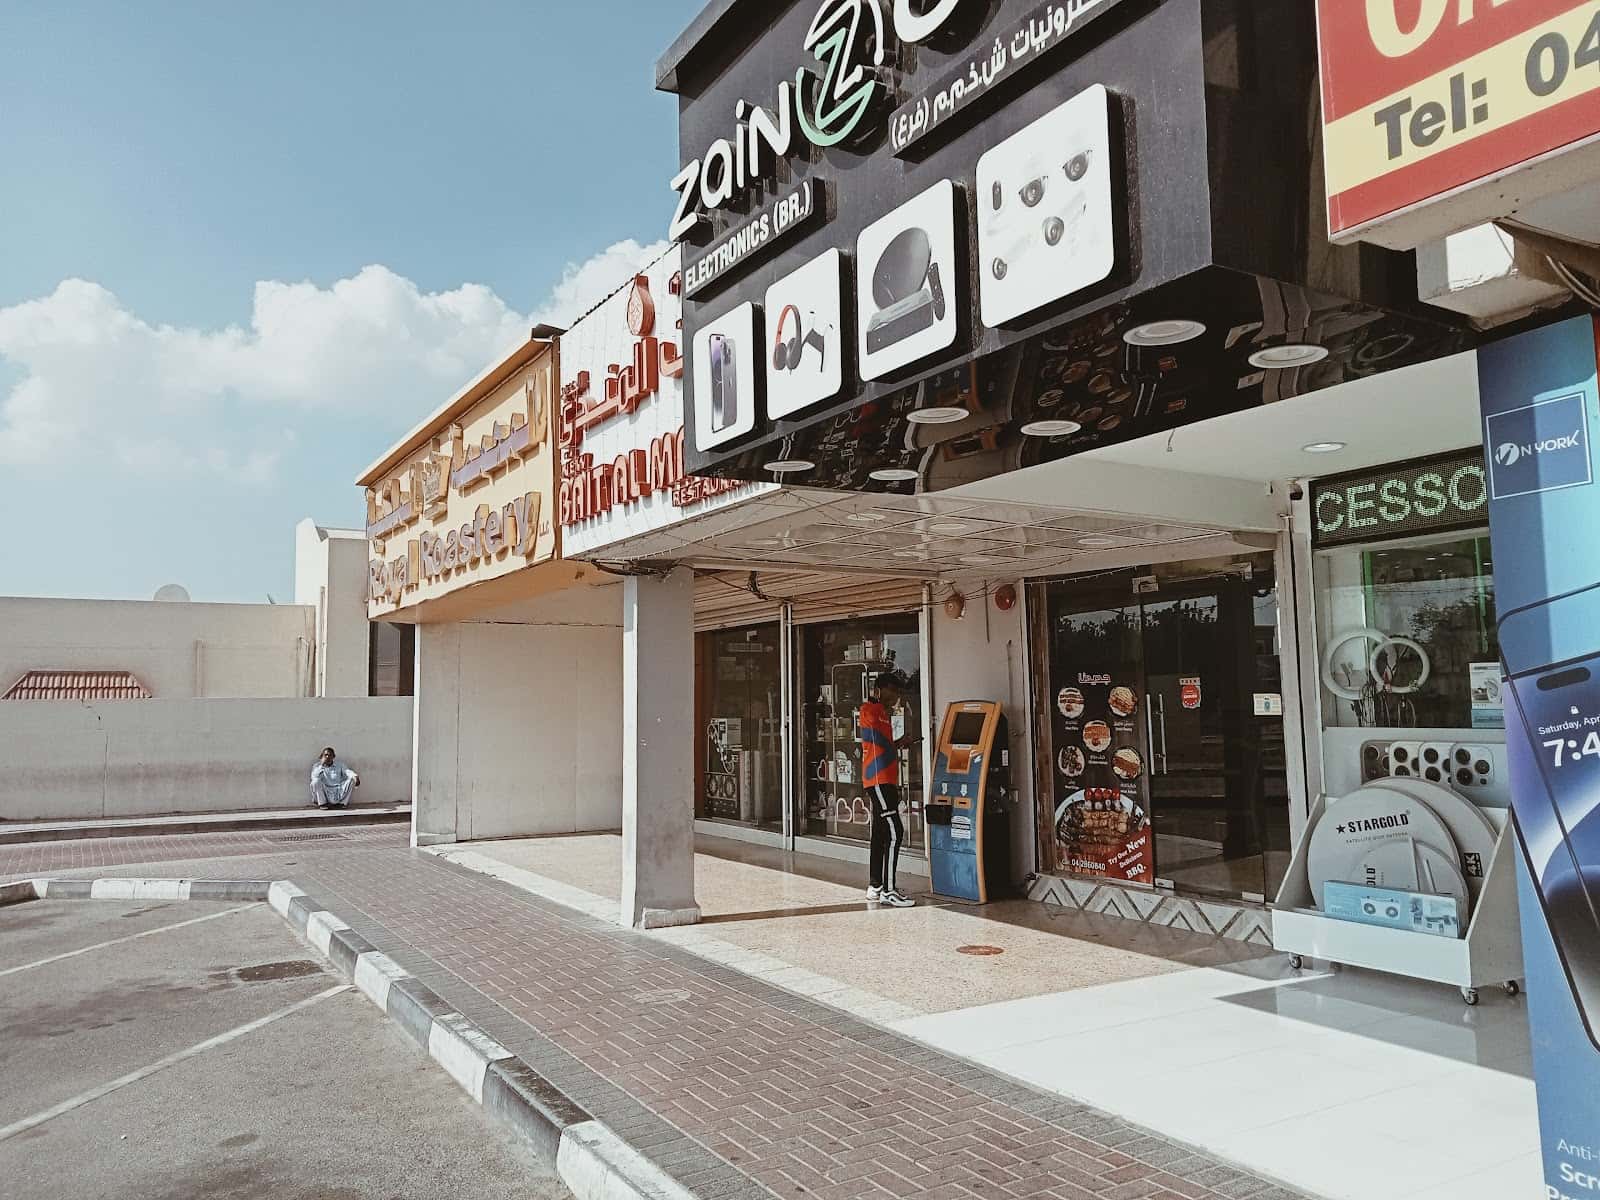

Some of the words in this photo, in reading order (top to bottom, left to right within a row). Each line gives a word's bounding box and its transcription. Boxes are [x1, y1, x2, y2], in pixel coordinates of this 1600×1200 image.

[1374, 72, 1488, 161] Tel:
[686, 213, 769, 293] ELECTRONICS
[773, 181, 811, 234] (BR.)
[1534, 429, 1580, 454] YORK
[559, 464, 612, 525] BAIT
[613, 449, 646, 505] AL
[1316, 465, 1488, 532] CESSO
[369, 538, 419, 605] Royal
[420, 491, 542, 581] Roastery
[1538, 719, 1582, 735] Saturday,
[1126, 836, 1146, 853] New
[1348, 813, 1409, 834] STARGOLD
